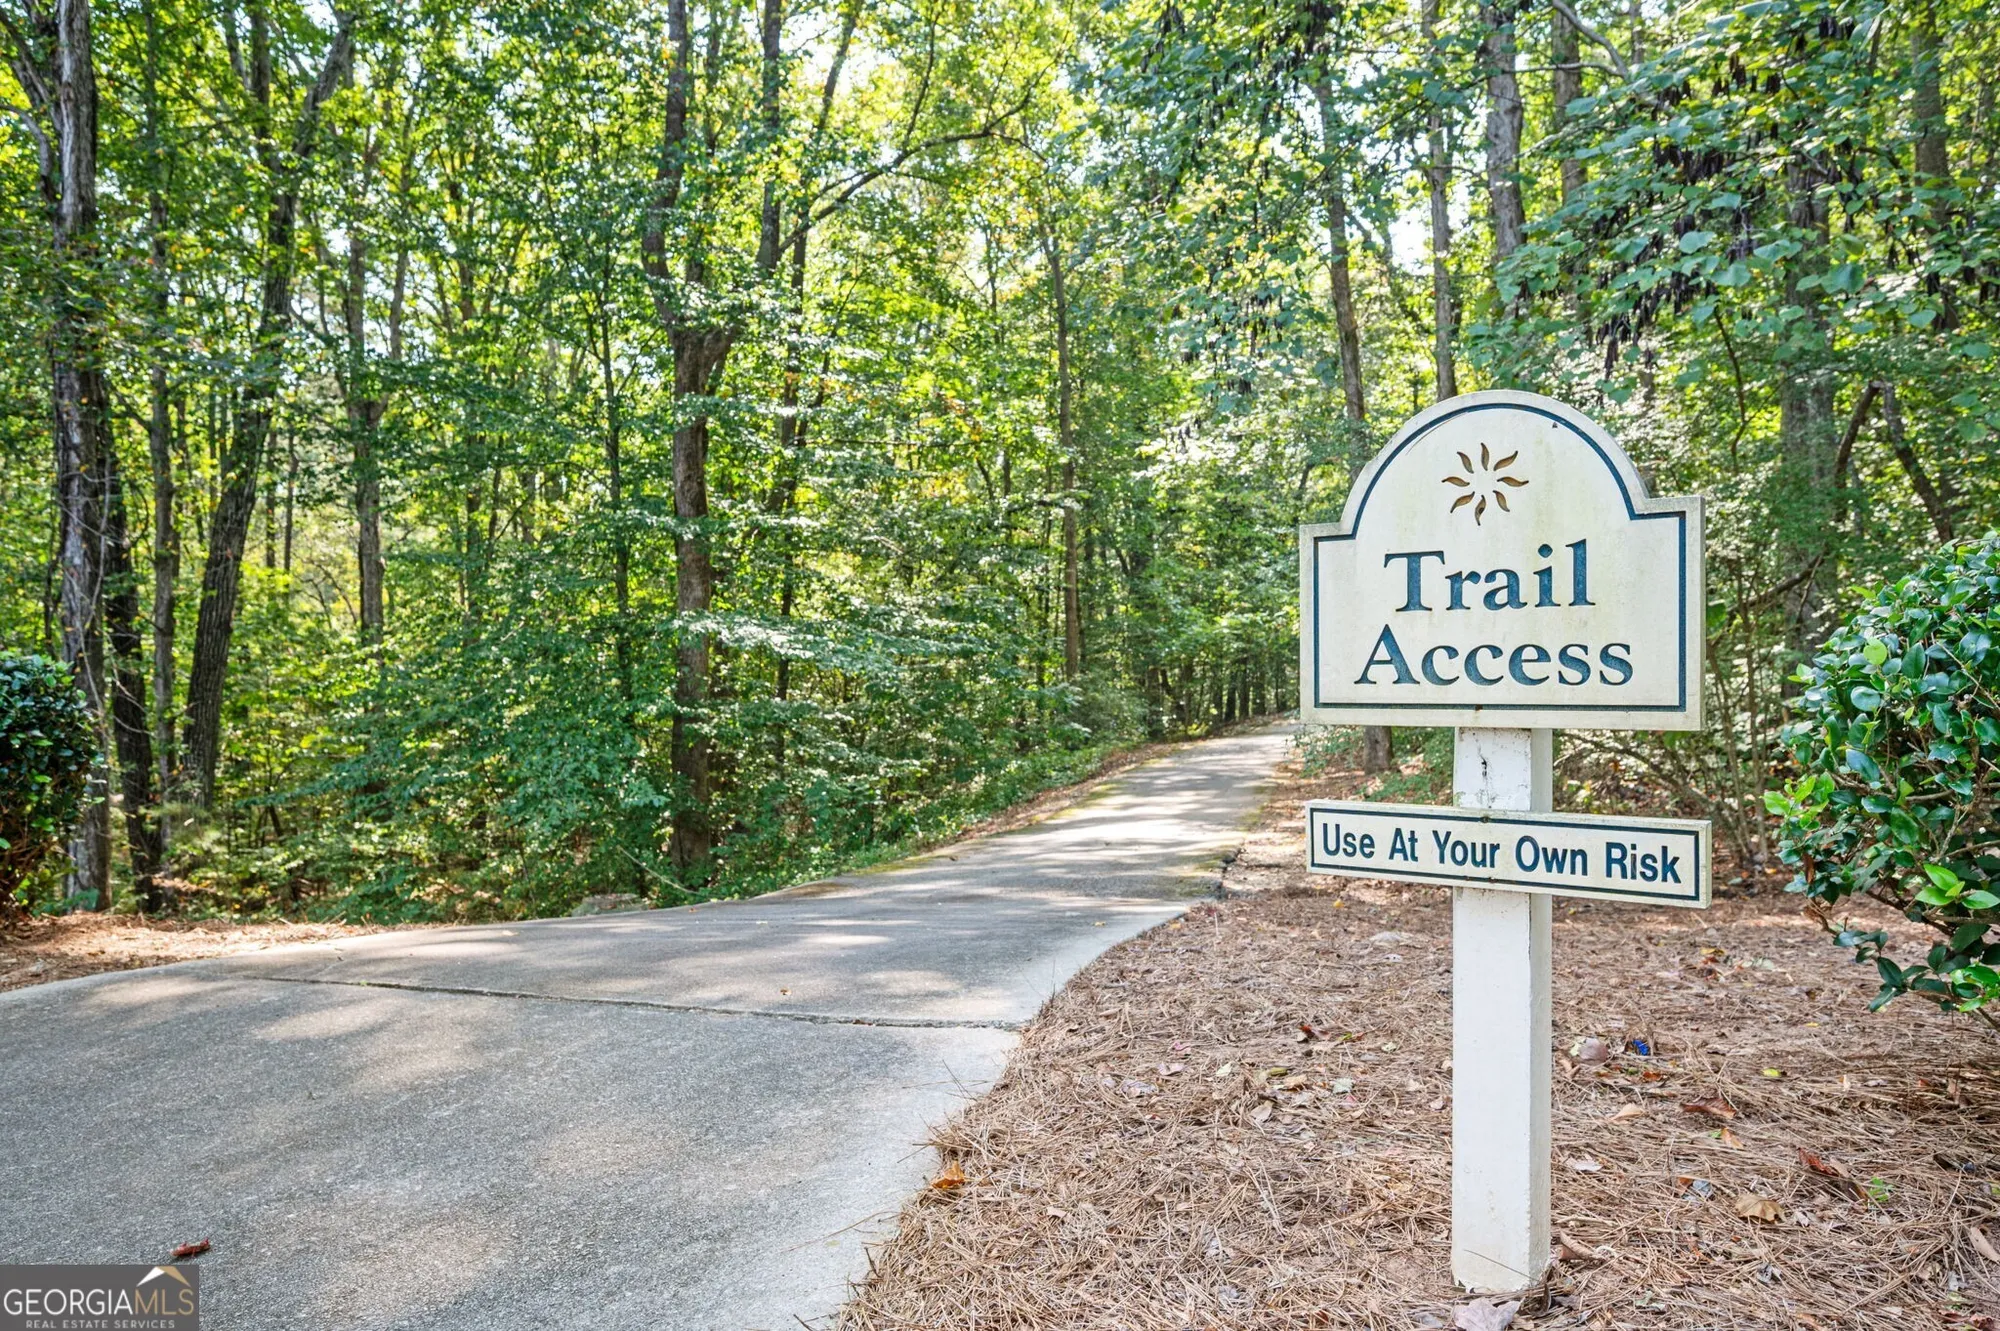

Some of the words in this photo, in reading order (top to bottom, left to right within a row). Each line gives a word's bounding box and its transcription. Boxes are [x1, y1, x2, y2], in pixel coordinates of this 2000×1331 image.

[1384, 538, 1596, 613] Trail
[1353, 623, 1634, 686] Access
[1322, 822, 1375, 858] Use
[1389, 827, 1419, 863] At
[1431, 829, 1501, 869] Your
[1514, 834, 1588, 877] Own
[1604, 841, 1681, 885] Risk
